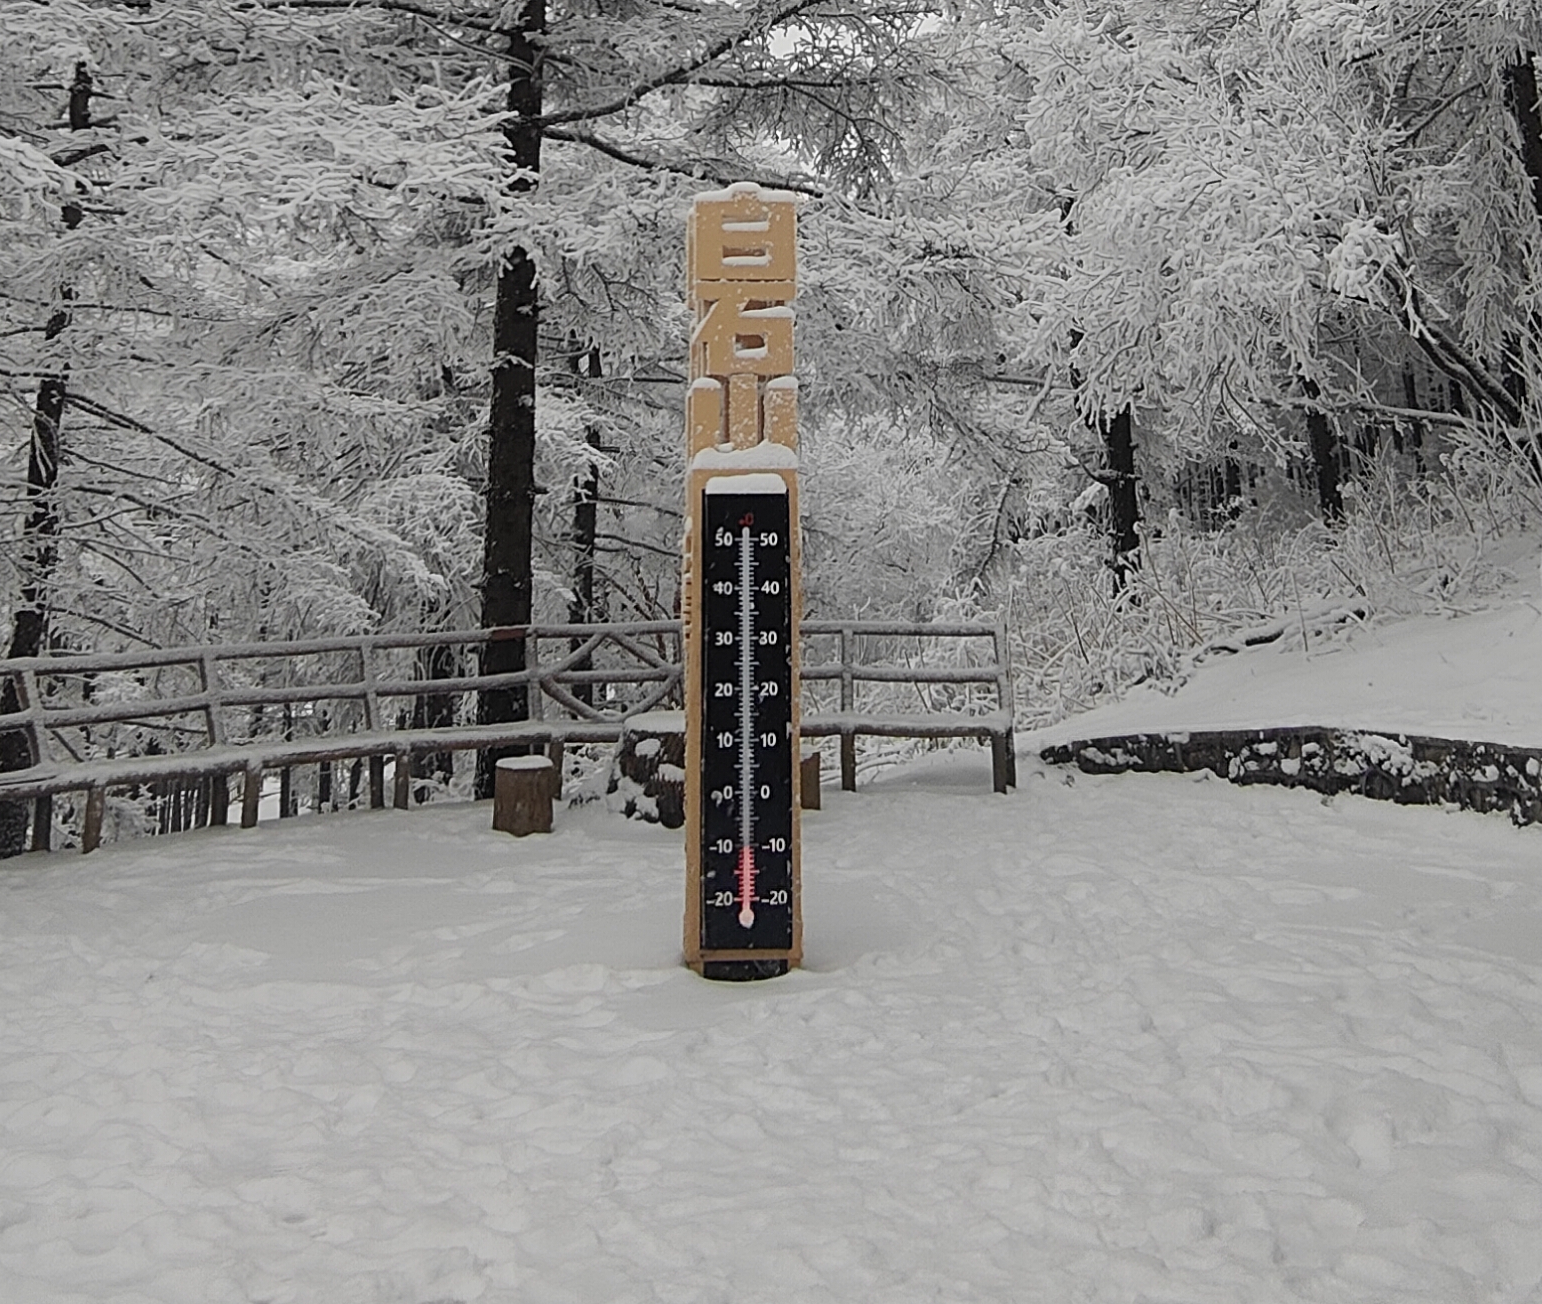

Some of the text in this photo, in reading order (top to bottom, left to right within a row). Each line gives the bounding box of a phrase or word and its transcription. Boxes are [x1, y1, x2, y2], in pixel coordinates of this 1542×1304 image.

[688, 188, 798, 462] 白石山
[715, 532, 733, 547] 50
[760, 532, 778, 547] 50
[713, 581, 733, 595] 40
[760, 580, 780, 595] 40
[715, 631, 733, 646] 30
[759, 631, 777, 645] 30
[714, 683, 733, 697] 20
[760, 681, 778, 696] 20
[716, 732, 734, 749] 10
[760, 732, 777, 747] 10
[723, 785, 733, 800] 0
[760, 785, 771, 800] 0
[709, 839, 733, 853] -10
[761, 838, 786, 852] -10
[706, 891, 733, 907] -20
[761, 890, 788, 905] -20
